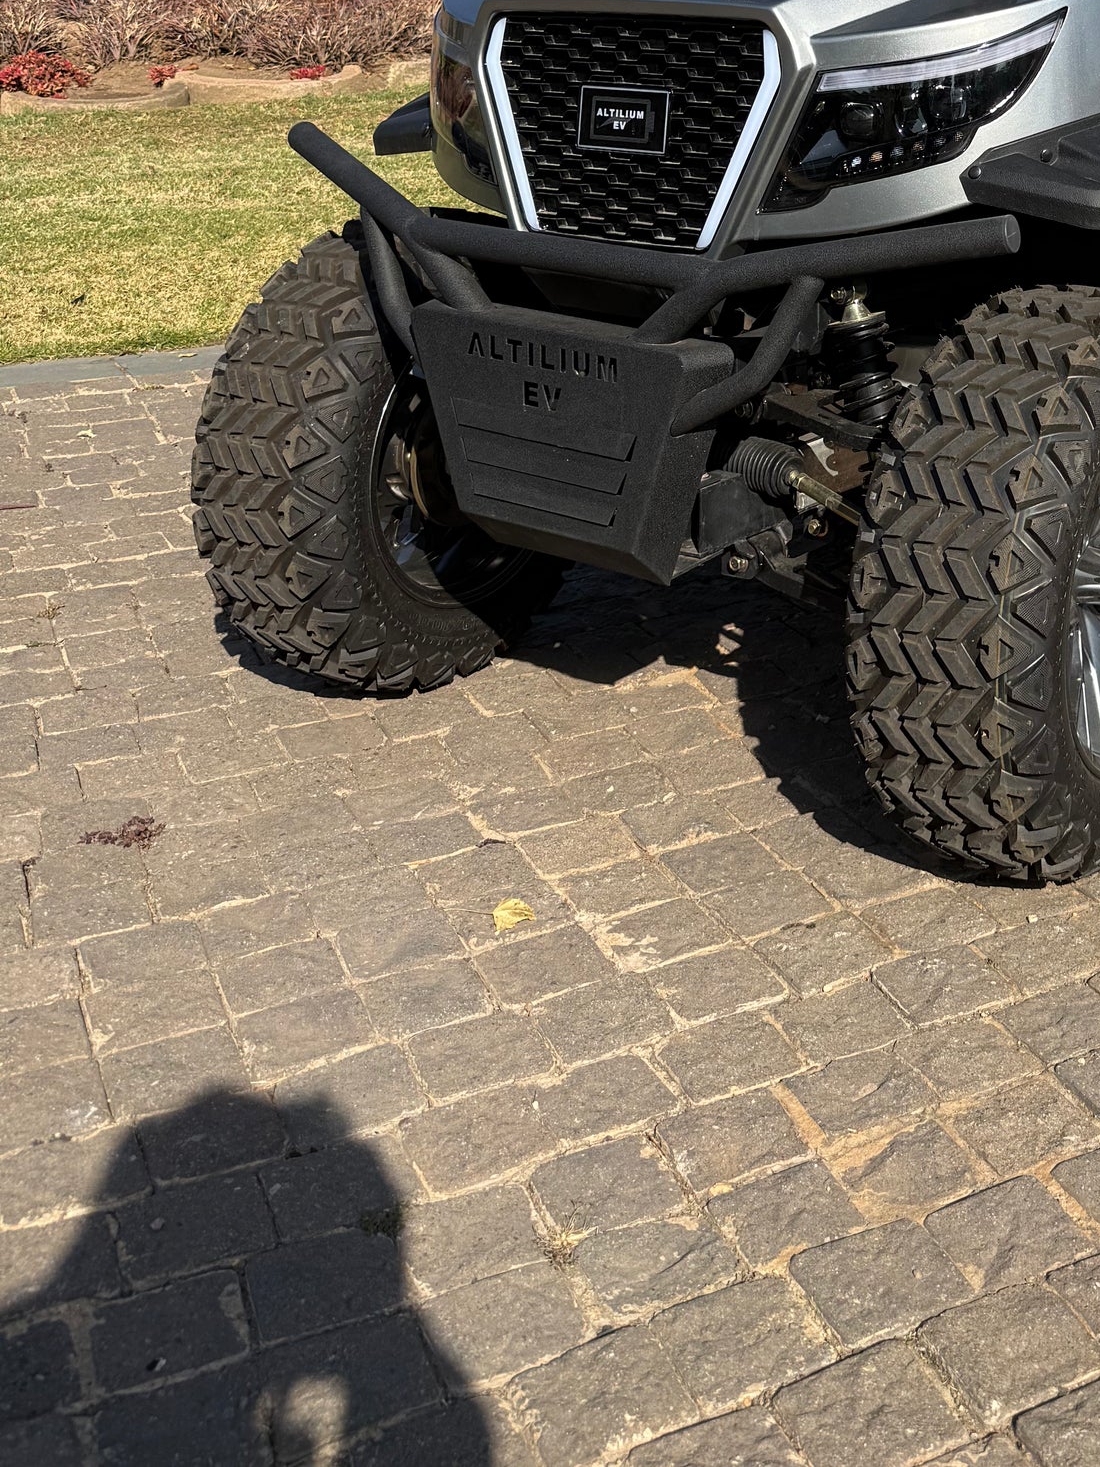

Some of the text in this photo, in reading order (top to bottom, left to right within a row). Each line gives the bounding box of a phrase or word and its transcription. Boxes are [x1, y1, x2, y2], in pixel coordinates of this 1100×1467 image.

[596, 107, 645, 120] ALTILIUM
[613, 120, 627, 130] EV
[467, 331, 618, 383] ALTILIUM
[522, 380, 562, 411] EV
